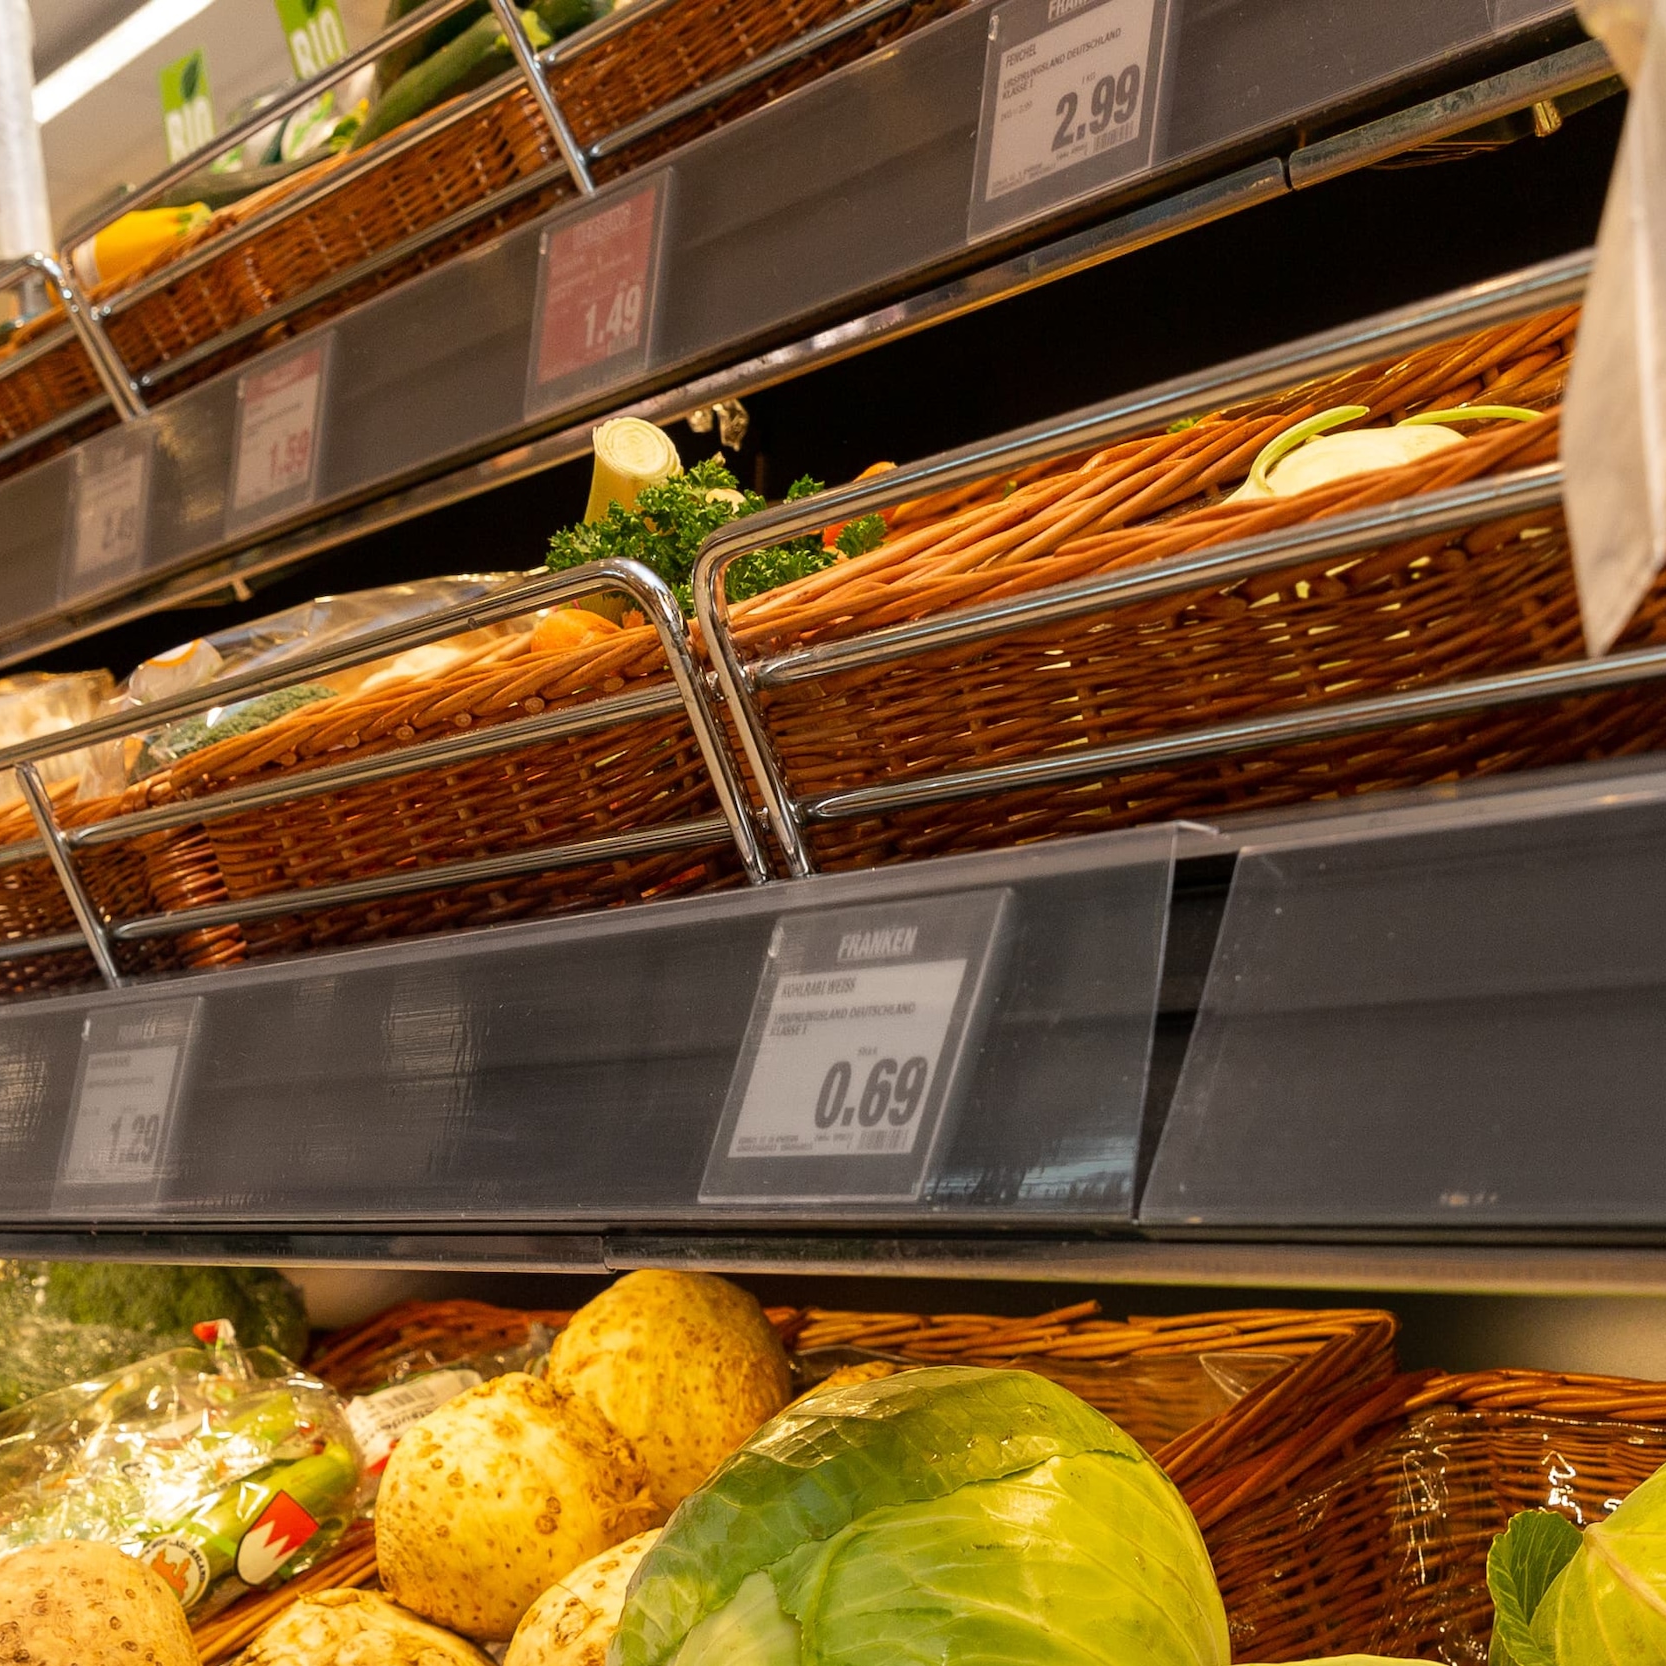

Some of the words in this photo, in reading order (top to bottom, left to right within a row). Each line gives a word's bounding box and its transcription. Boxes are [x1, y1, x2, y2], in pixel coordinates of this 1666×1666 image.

[1003, 54, 1066, 90] URSPRUNGSLAND
[1066, 27, 1122, 61] DEUTSCHLAND
[1005, 43, 1037, 68] FENCHEL
[1002, 82, 1030, 100] KLASSE
[1051, 64, 1140, 152] 2.99
[585, 284, 643, 348] 1.49
[837, 926, 918, 961] FRANKEN
[827, 977, 857, 996] WEISS
[848, 1001, 916, 1020] DEUTSCHLAND
[814, 1056, 928, 1129] 0.69
[108, 1113, 159, 1164] 1.29
